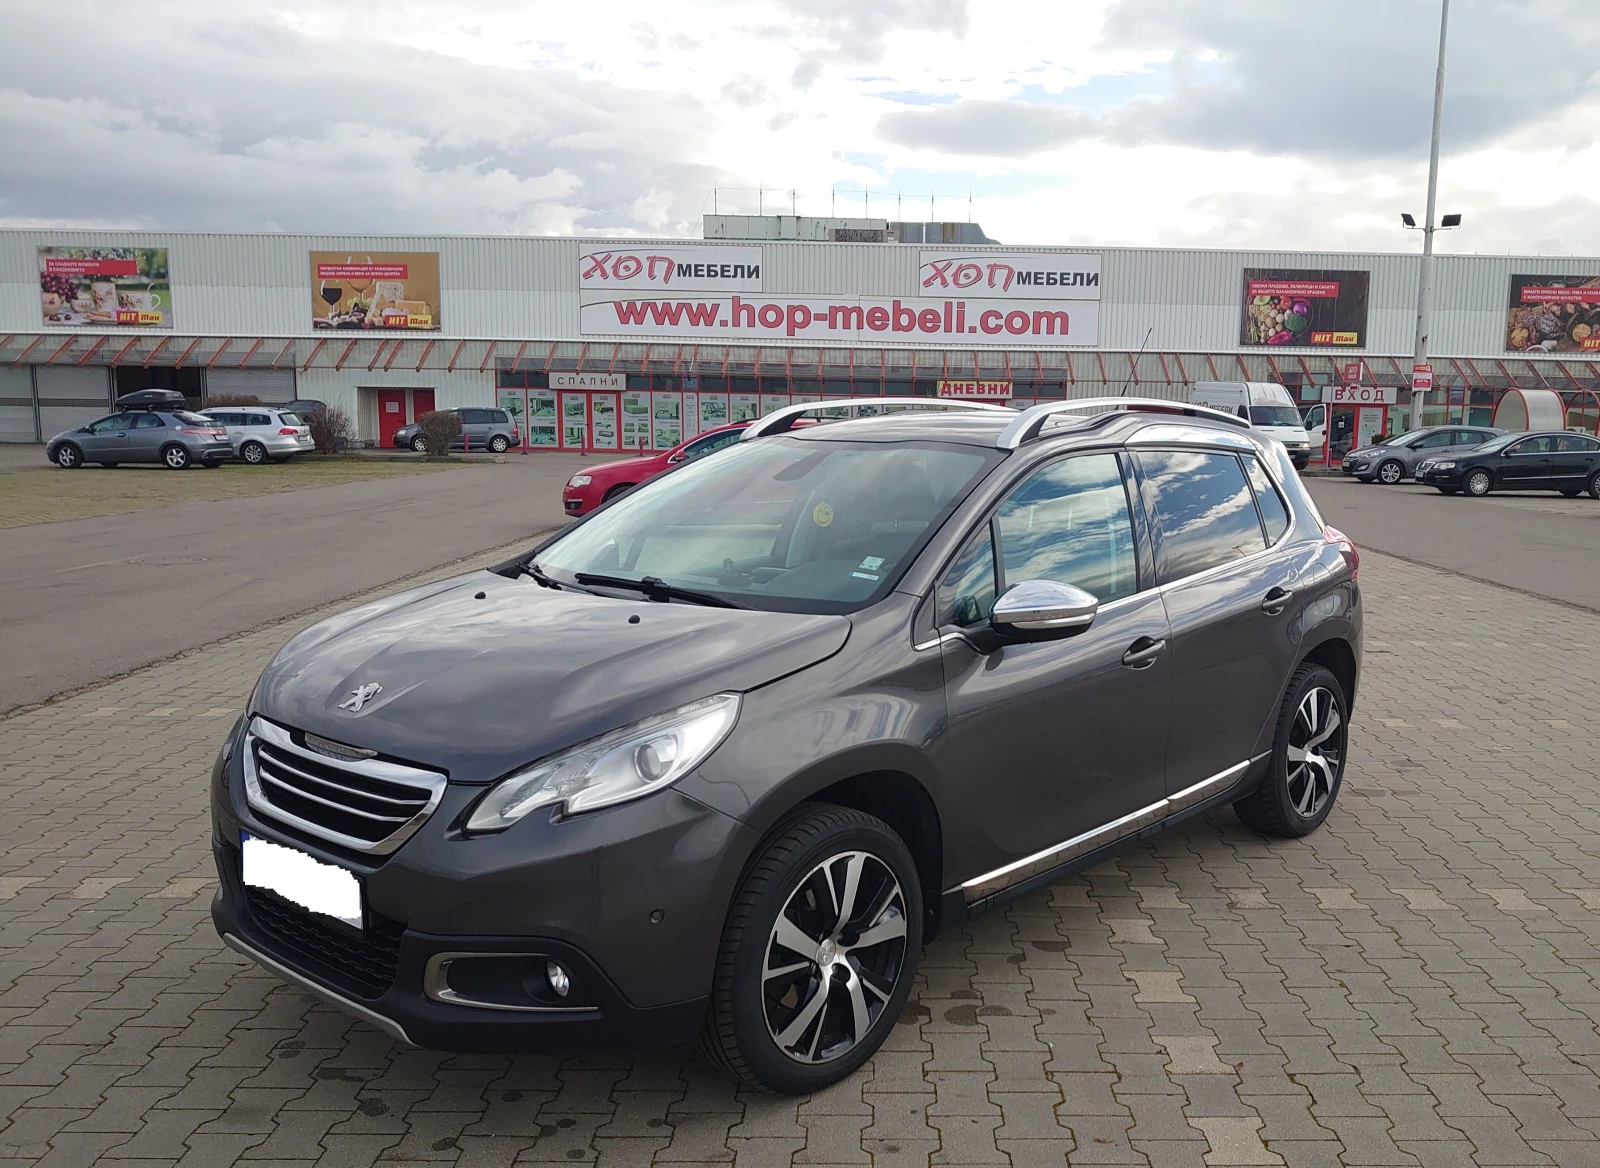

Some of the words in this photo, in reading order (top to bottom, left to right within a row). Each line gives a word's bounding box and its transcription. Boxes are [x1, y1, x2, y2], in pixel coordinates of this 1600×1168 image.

[582, 252, 676, 284] ХОП
[677, 263, 760, 279] МЕБЕЛИ
[922, 260, 1016, 292] ХОП
[1016, 271, 1099, 287] МЕБЕЛИ
[119, 312, 137, 321] HIT
[388, 316, 406, 325] HIT
[613, 295, 1069, 337] www.hop-mebeli.com
[1314, 333, 1332, 342] HIT
[557, 376, 618, 386] СПАЛНИ
[940, 383, 1010, 396] ДНЕВНИ
[1335, 389, 1384, 403] ВХОД
